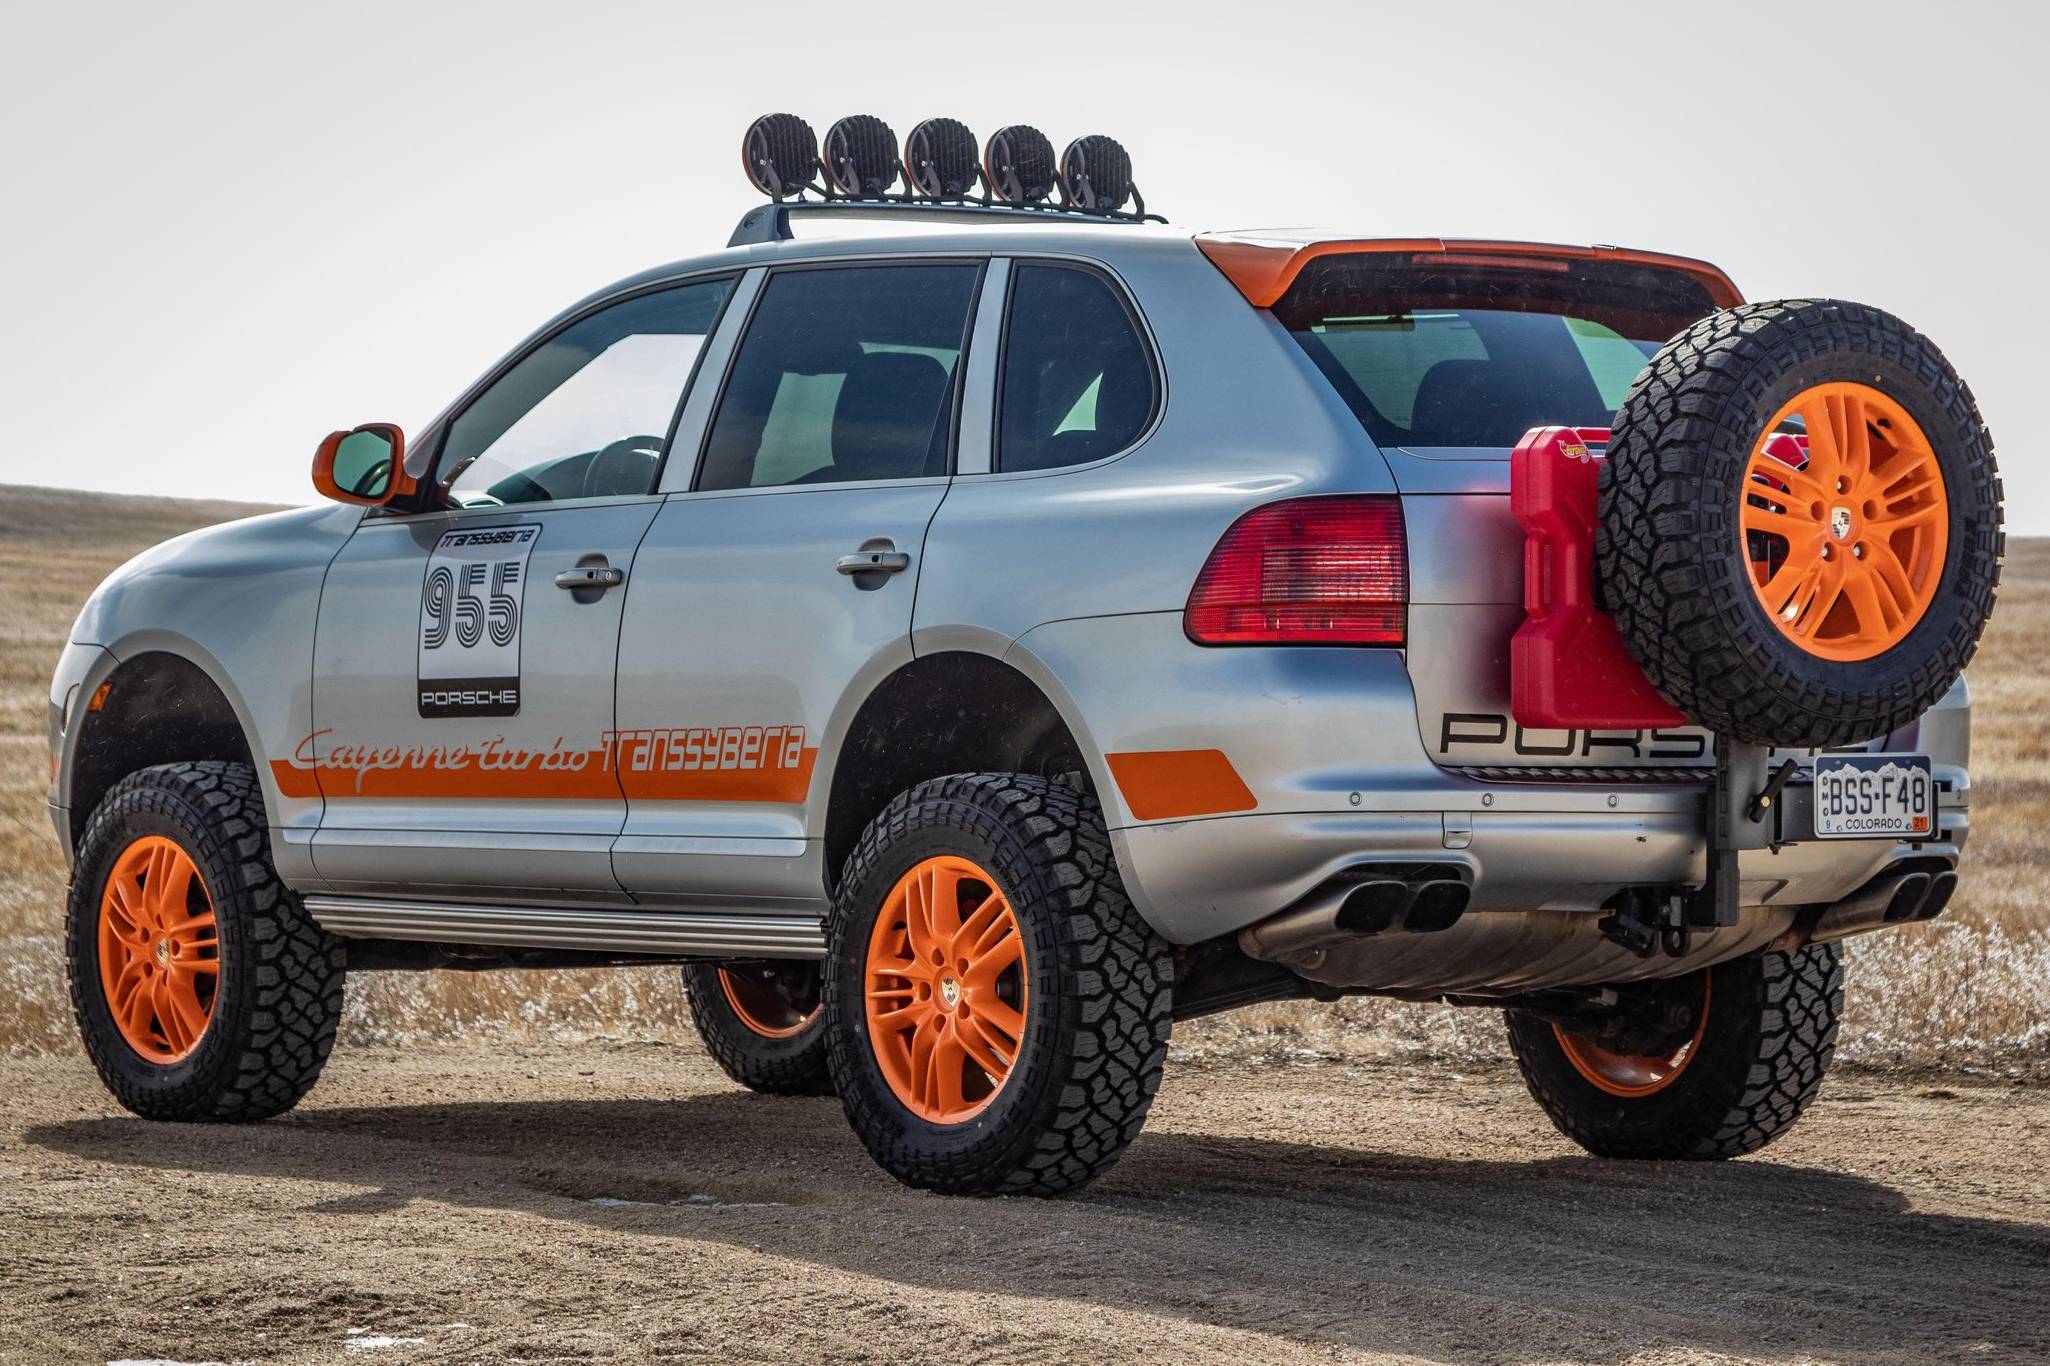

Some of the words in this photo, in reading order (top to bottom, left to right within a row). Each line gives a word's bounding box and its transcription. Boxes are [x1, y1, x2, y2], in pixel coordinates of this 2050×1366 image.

[424, 561, 520, 650] 955
[421, 690, 517, 706] PORSCHE
[1440, 713, 1867, 758] PORS
[294, 728, 471, 793] Cayenne
[479, 737, 589, 771] turbo
[1845, 818, 1903, 830] COLORADO
